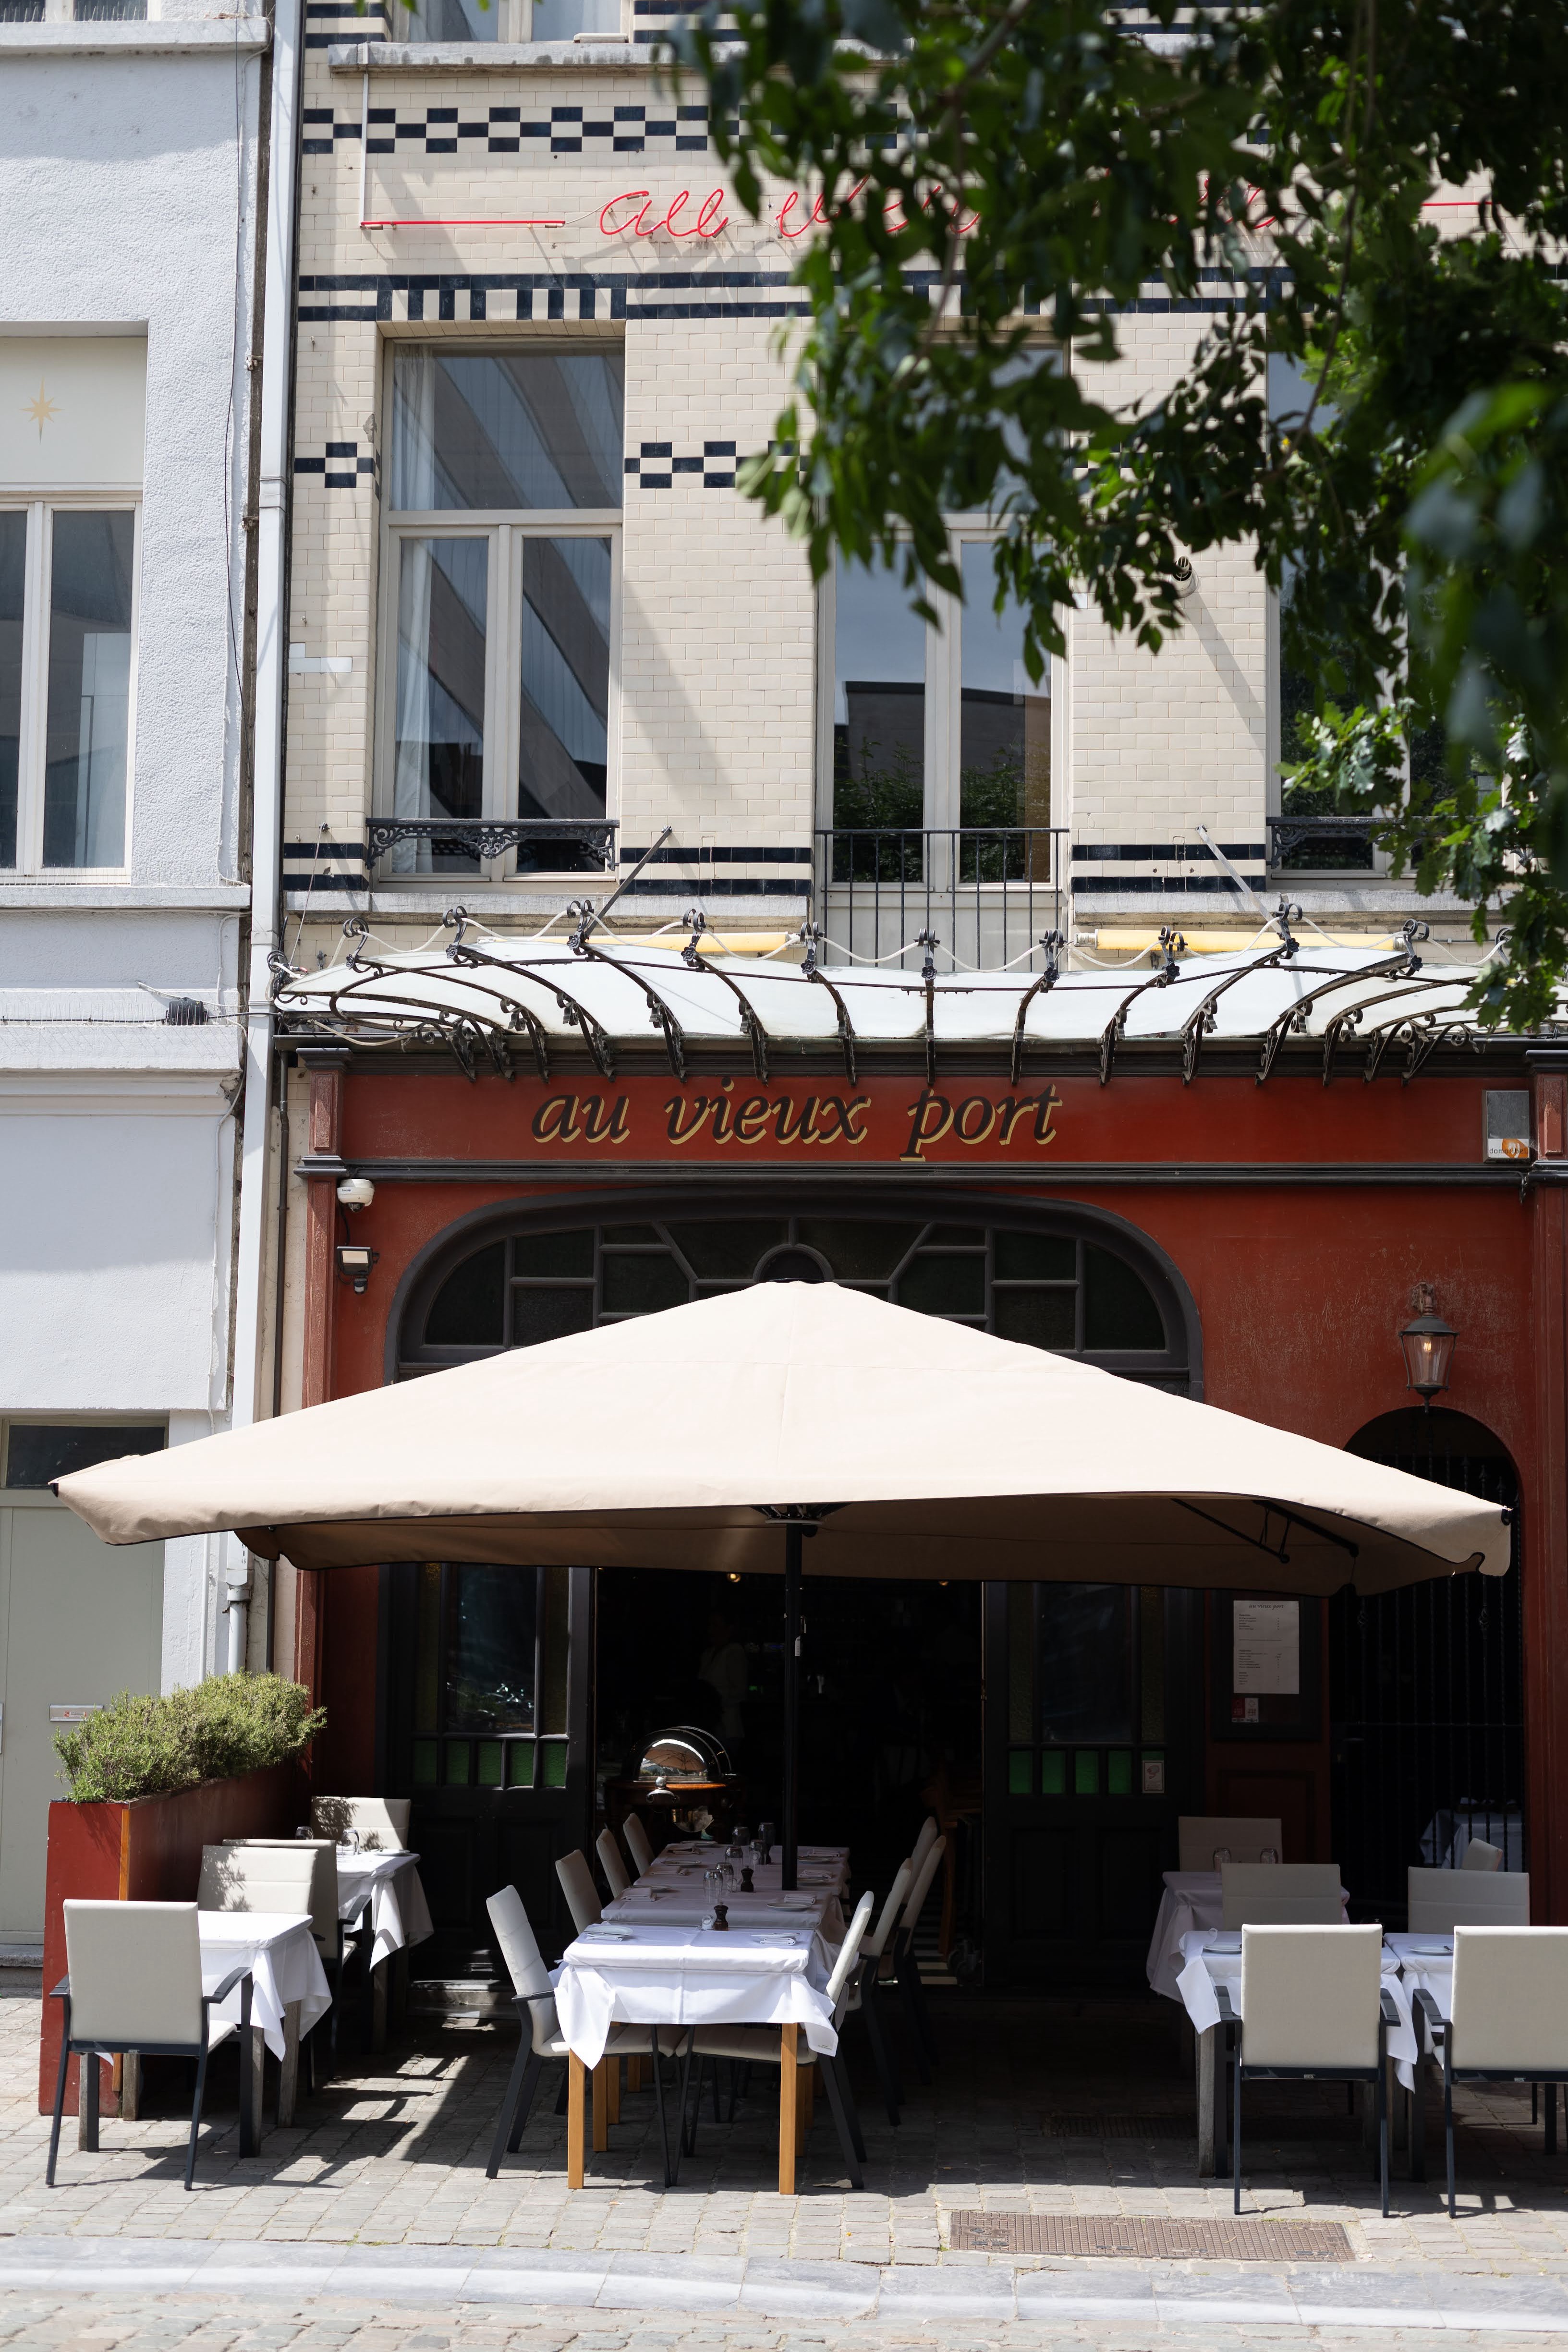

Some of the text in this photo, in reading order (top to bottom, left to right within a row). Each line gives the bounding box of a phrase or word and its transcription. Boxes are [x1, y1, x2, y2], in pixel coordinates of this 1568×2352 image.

[531, 1076, 1064, 1162] au vieux port
